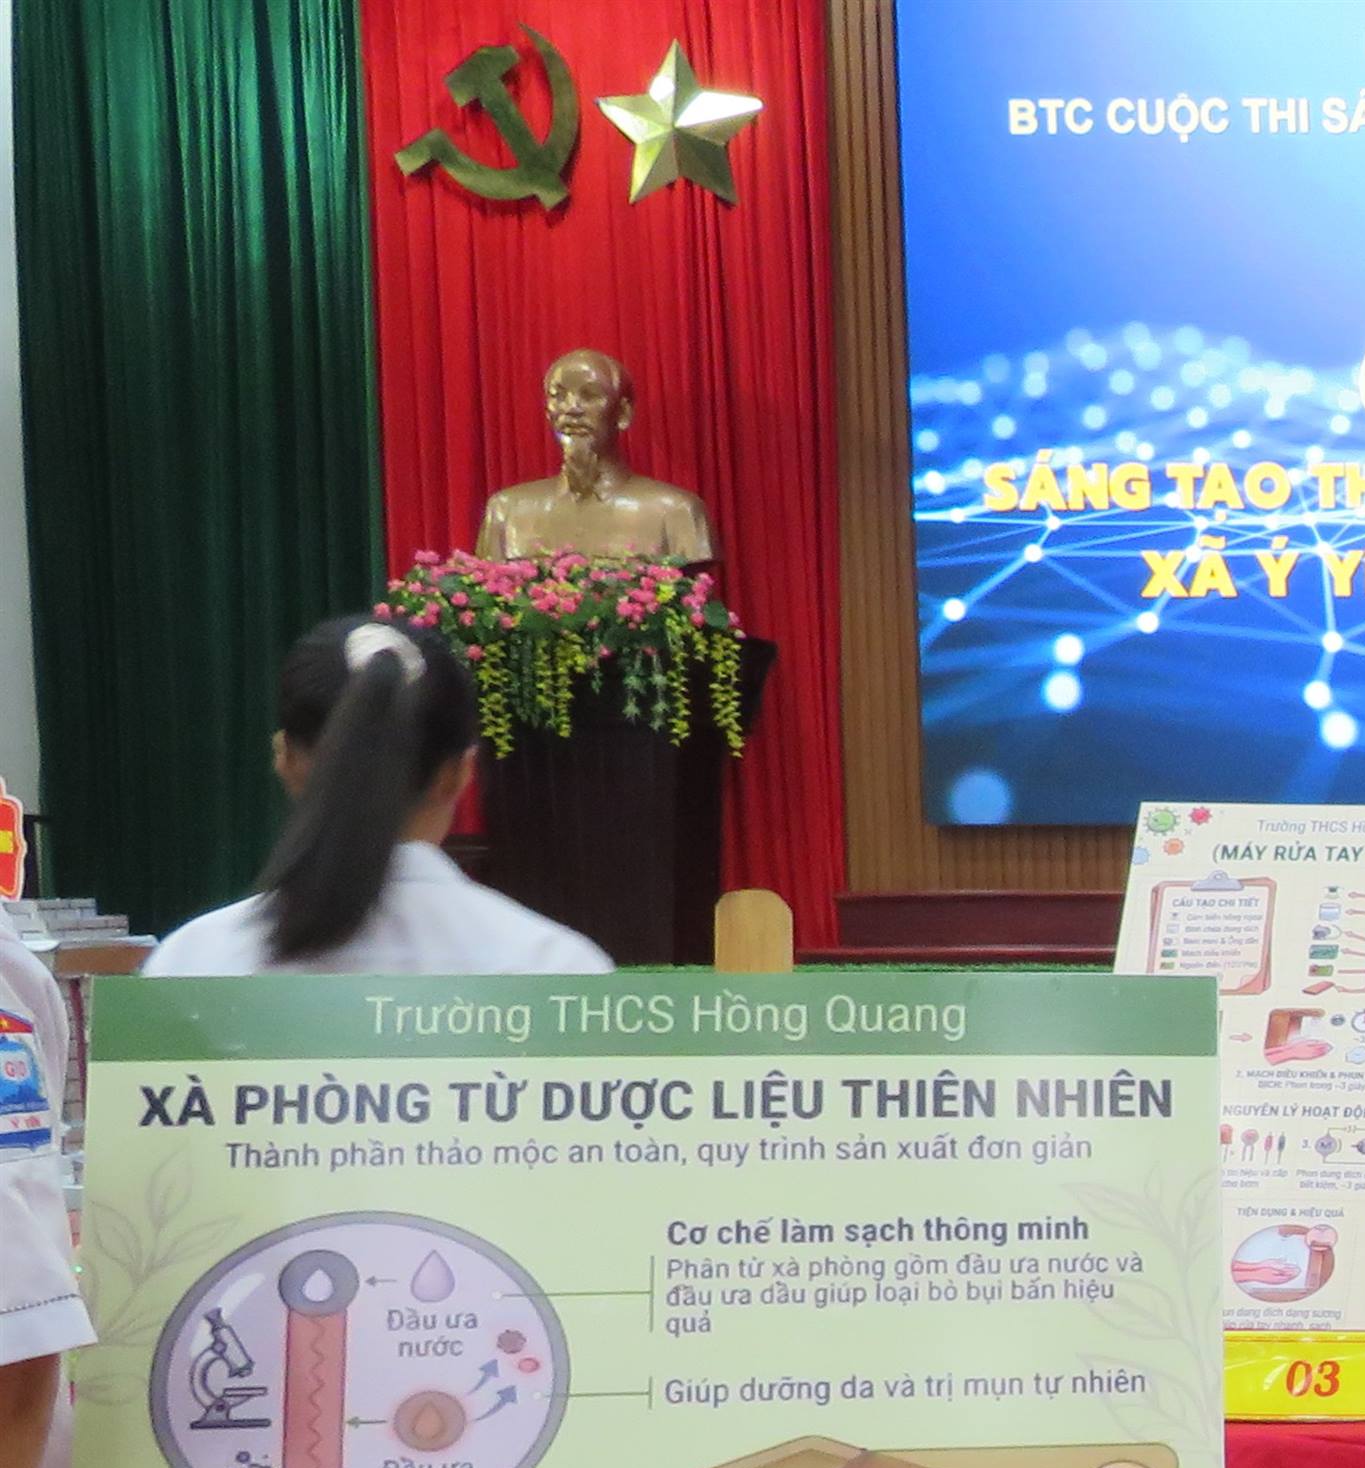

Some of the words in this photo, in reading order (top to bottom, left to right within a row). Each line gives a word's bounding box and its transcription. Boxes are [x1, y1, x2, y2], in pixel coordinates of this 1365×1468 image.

[1009, 99, 1093, 135] BTC
[1107, 93, 1229, 143] CUỘC
[1242, 97, 1309, 133] THI
[984, 450, 1151, 511] SÁNG
[1166, 461, 1292, 522] TẠO
[1141, 535, 1236, 596] XÃ
[1249, 537, 1298, 596] Ý
[1213, 842, 1267, 863] (MÁY
[1273, 843, 1317, 863] RỬA
[1323, 847, 1364, 863] TAY
[366, 996, 531, 1042] Trường
[549, 995, 674, 1034] THCS
[692, 990, 808, 1041] Hồng
[825, 995, 966, 1040] Quang
[137, 1074, 215, 1127] XÀ
[234, 1074, 430, 1125] PHÒNG
[449, 1071, 528, 1122] TỪ
[542, 1078, 693, 1129] DƯỢC
[713, 1070, 824, 1128] LIỆU
[842, 1069, 996, 1119] THIÊN
[1016, 1069, 1173, 1118] NHIÊN
[226, 1142, 319, 1170] Thành
[330, 1138, 404, 1172] phần
[416, 1138, 482, 1166] thảo
[494, 1138, 558, 1170] mộc
[569, 1142, 603, 1163] an
[615, 1139, 687, 1165] toàn,
[697, 1142, 749, 1166] quy
[760, 1134, 826, 1161] trình
[836, 1133, 886, 1160] sản
[898, 1133, 958, 1159] xuất
[968, 1133, 1021, 1159] đơn
[1032, 1133, 1092, 1165] giản
[667, 1220, 708, 1245] Cơ
[717, 1218, 772, 1244] chế
[781, 1218, 834, 1243] làm
[844, 1218, 914, 1248] sạch
[924, 1217, 1008, 1245] thông
[1017, 1216, 1089, 1241] minh
[664, 1374, 729, 1408] Giúp
[739, 1375, 830, 1404] dưỡng
[841, 1376, 874, 1400] da
[885, 1372, 915, 1397] và
[925, 1371, 953, 1401] trị
[963, 1377, 1024, 1401] mụn
[1034, 1372, 1064, 1399] tự
[1071, 1370, 1146, 1396] nhiên
[1286, 1360, 1340, 1397] 03
